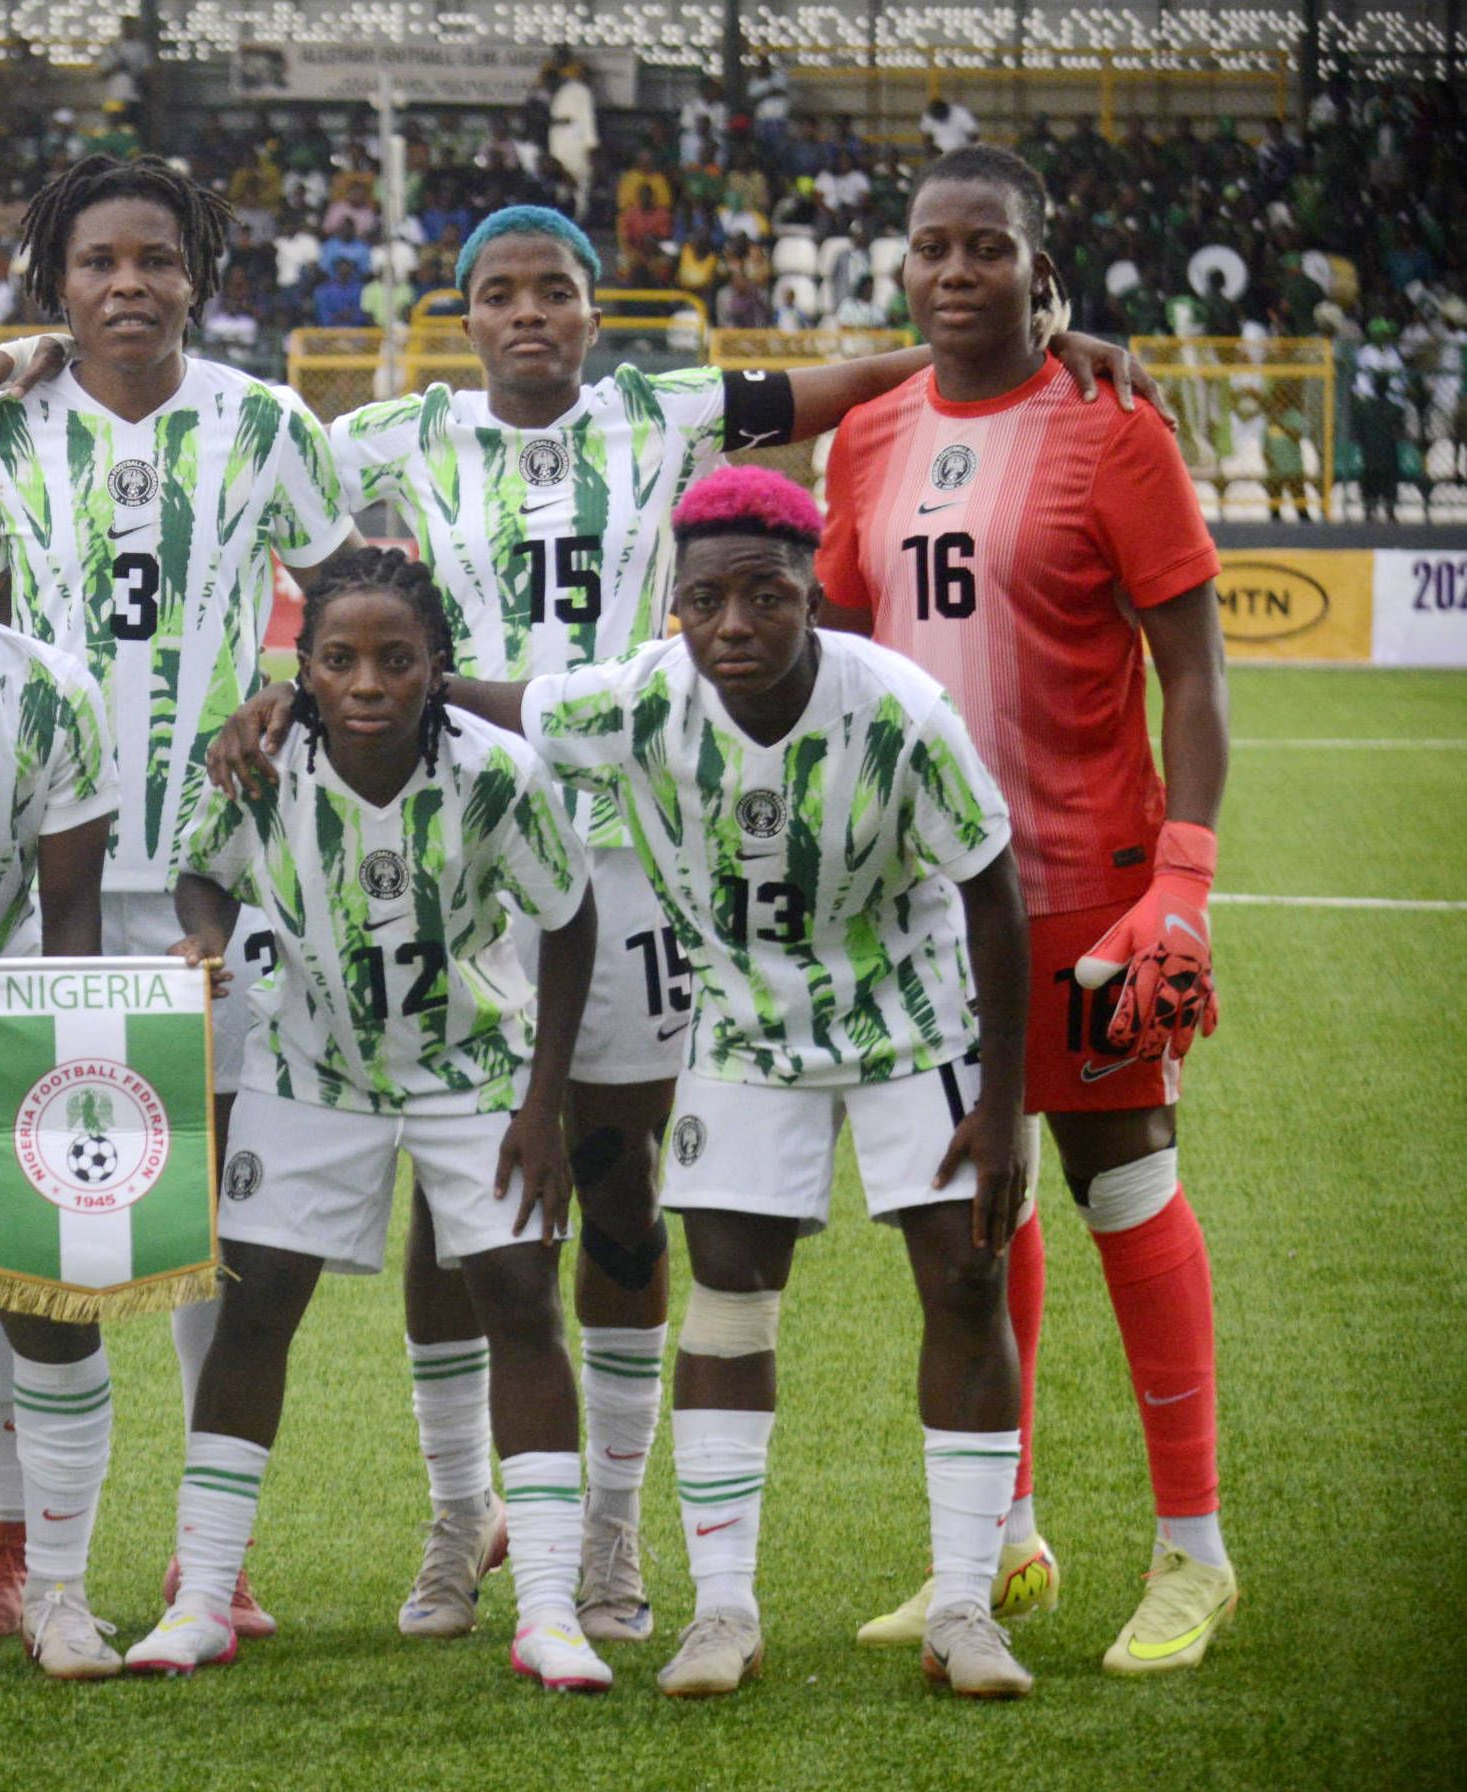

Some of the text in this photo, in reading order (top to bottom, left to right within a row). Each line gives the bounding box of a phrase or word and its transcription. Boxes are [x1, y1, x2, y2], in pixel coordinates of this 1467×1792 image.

[110, 553, 159, 639] 3
[512, 535, 601, 624] 15
[902, 532, 975, 620] 16
[716, 875, 805, 944] 13
[5, 974, 173, 1010] NIGERIA
[351, 943, 446, 1020] 12
[32, 1064, 118, 1105] FOOTBALL
[20, 1108, 46, 1181] NIGERIA
[123, 1075, 164, 1179] FEDERATION
[74, 1194, 116, 1208] 1945
